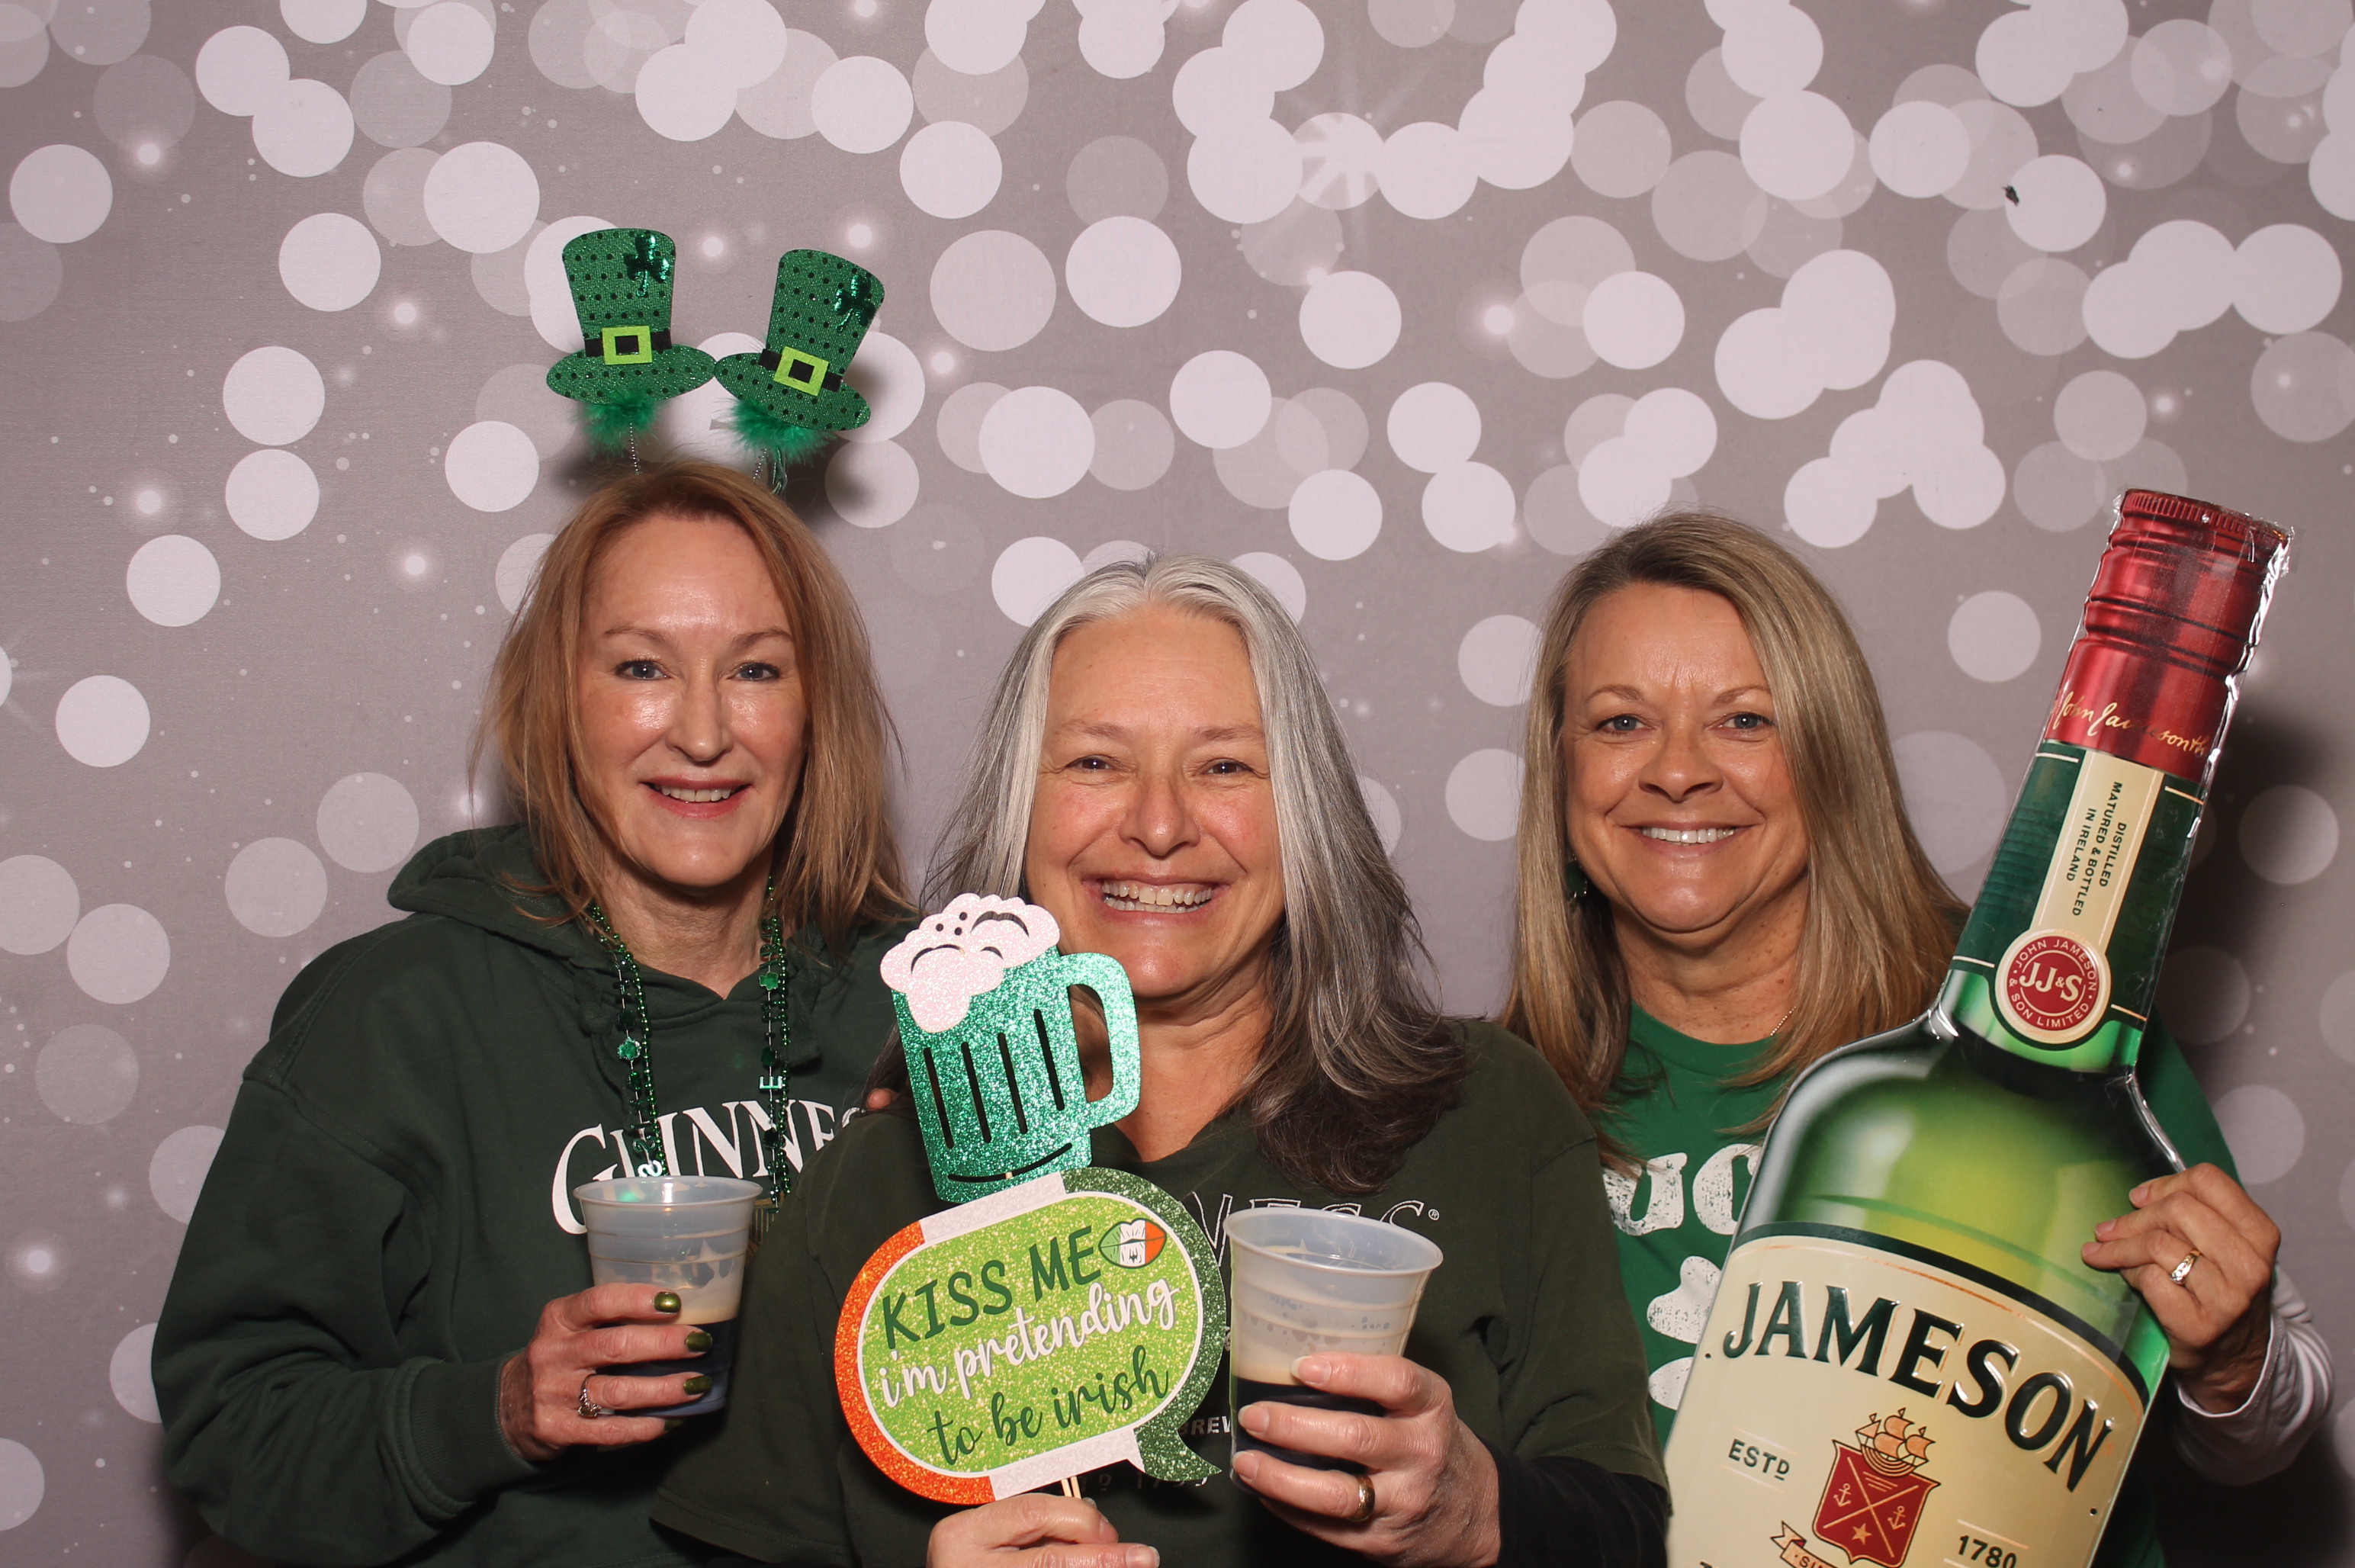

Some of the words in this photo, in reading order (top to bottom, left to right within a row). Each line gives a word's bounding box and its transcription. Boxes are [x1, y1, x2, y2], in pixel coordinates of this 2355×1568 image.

[2085, 808, 2096, 821] IN
[2096, 781, 2123, 843] MATURED
[2066, 824, 2091, 882] IRELAND
[2091, 847, 2101, 855] &
[2099, 822, 2127, 887] DISTILLED
[2072, 858, 2097, 916] BOTTLED
[2015, 940, 2047, 968] JOHN
[2053, 939, 2096, 991] JAMESON
[2011, 993, 2034, 1019] SON
[2036, 1003, 2089, 1028] LIMITED
[883, 1259, 1014, 1349] KISS
[1029, 1226, 1101, 1303] ME
[879, 1350, 948, 1408] i'm
[953, 1277, 1180, 1400] pretending
[927, 1409, 984, 1465] to
[991, 1392, 1046, 1446] be
[1051, 1345, 1168, 1429] irish
[1722, 1281, 2113, 1492] JAMESON
[1958, 1534, 2017, 1568] 1780
